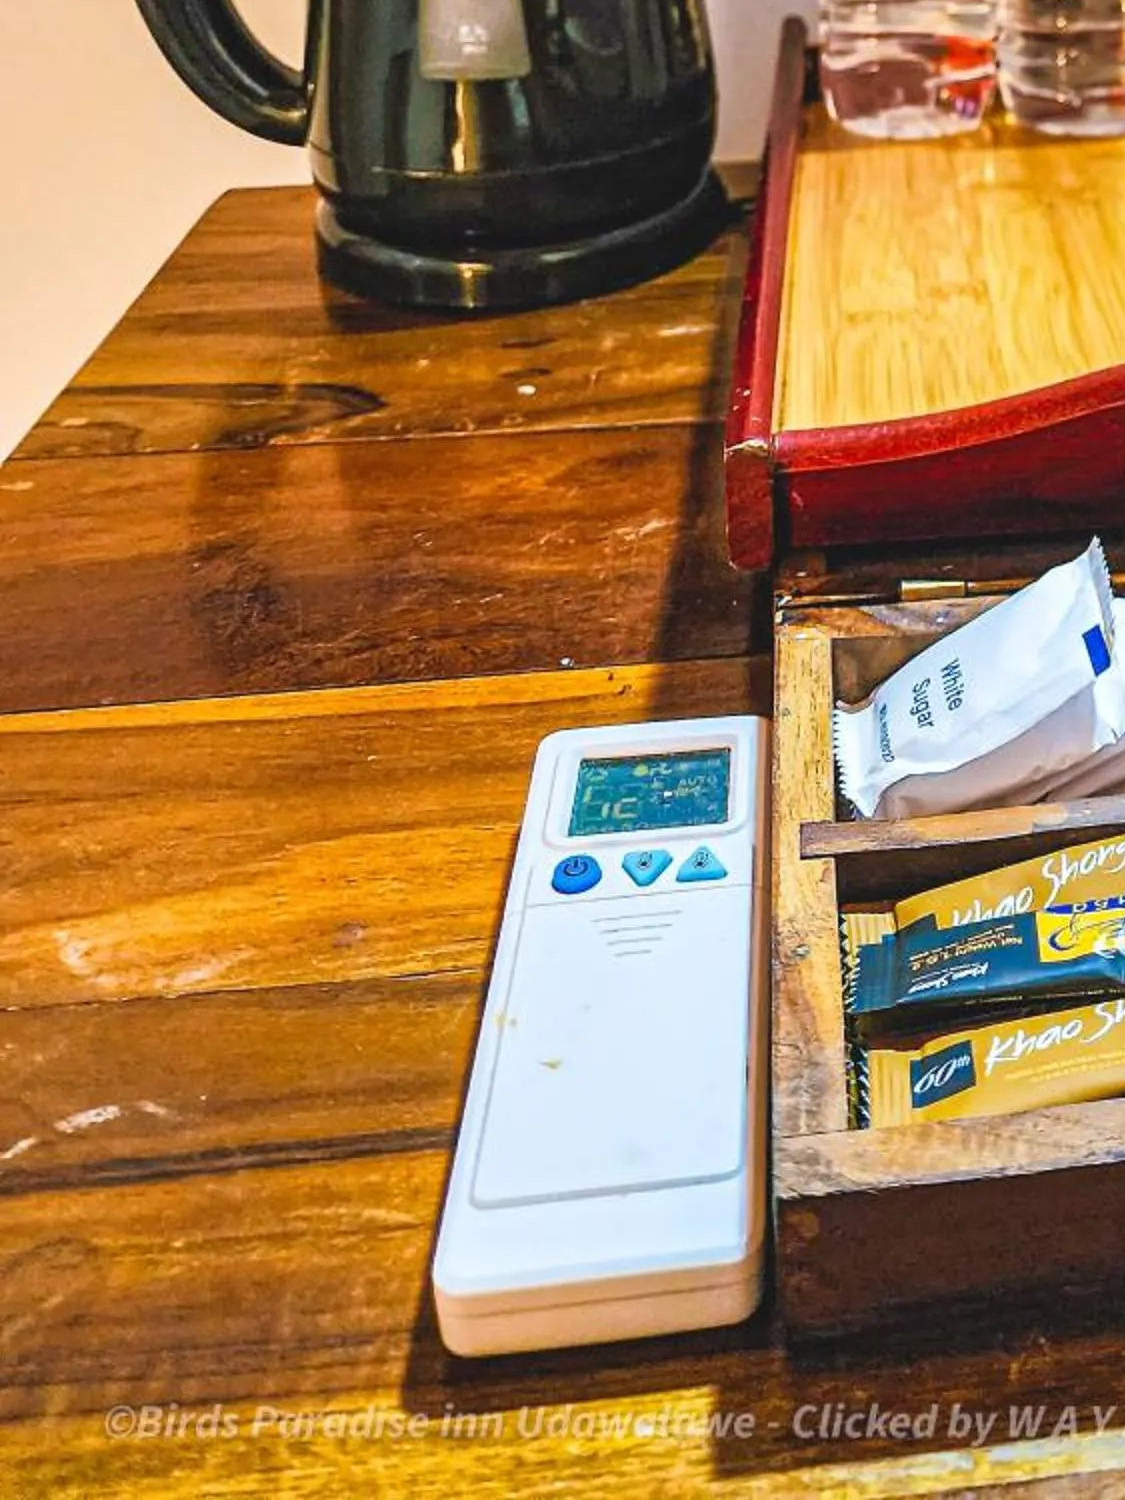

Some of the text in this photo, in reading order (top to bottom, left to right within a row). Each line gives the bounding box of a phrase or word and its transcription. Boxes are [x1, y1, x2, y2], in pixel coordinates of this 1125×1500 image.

[909, 677, 935, 728] Sugar
[941, 658, 964, 712] White
[984, 1019, 1083, 1076] Khao
